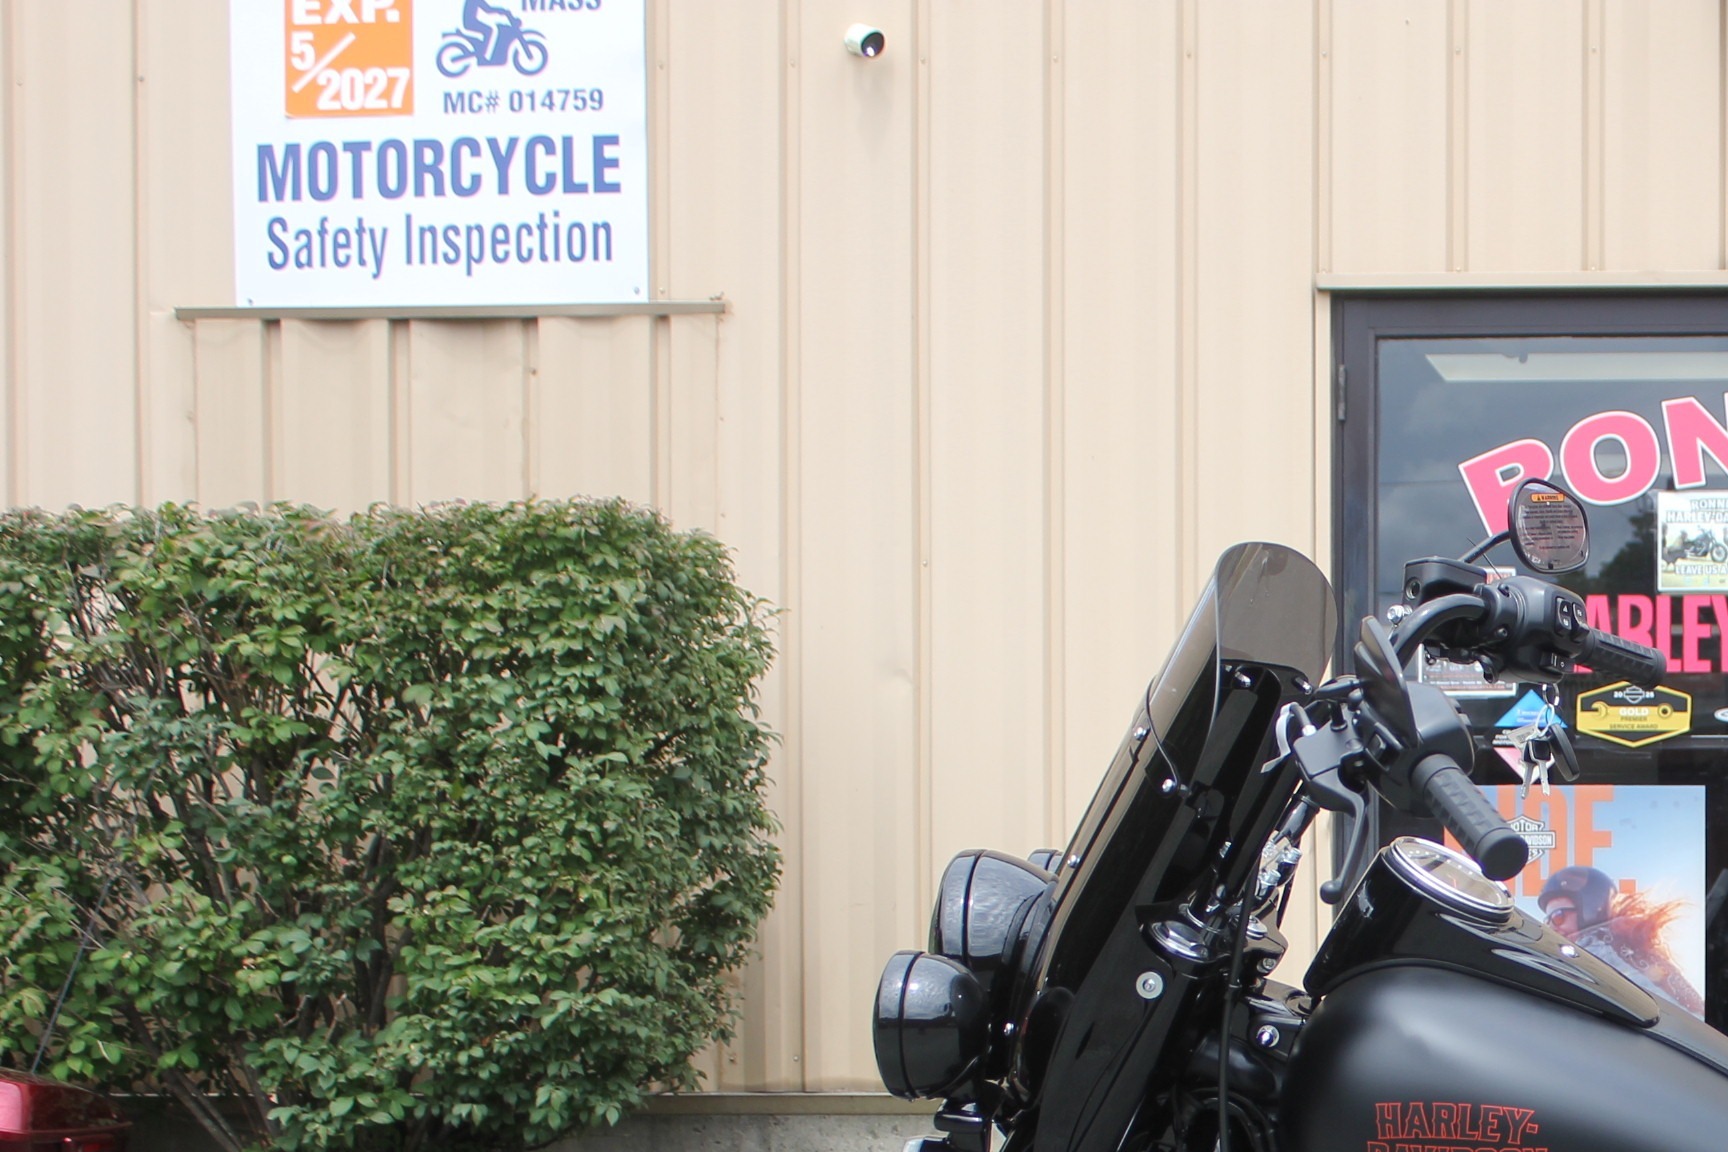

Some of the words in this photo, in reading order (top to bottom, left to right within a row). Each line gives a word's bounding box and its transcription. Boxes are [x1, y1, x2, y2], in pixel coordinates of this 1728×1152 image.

[293, 0, 400, 24] EXP.
[443, 90, 500, 114] MC#
[509, 88, 604, 113] 014759
[256, 134, 622, 203] MOTORCYCLE
[267, 215, 389, 280] Safety
[405, 209, 613, 277] Inspection
[1675, 564, 1704, 575] LEAVE
[1620, 707, 1649, 716] GOLD
[1375, 1102, 1539, 1145] HARLEY-
